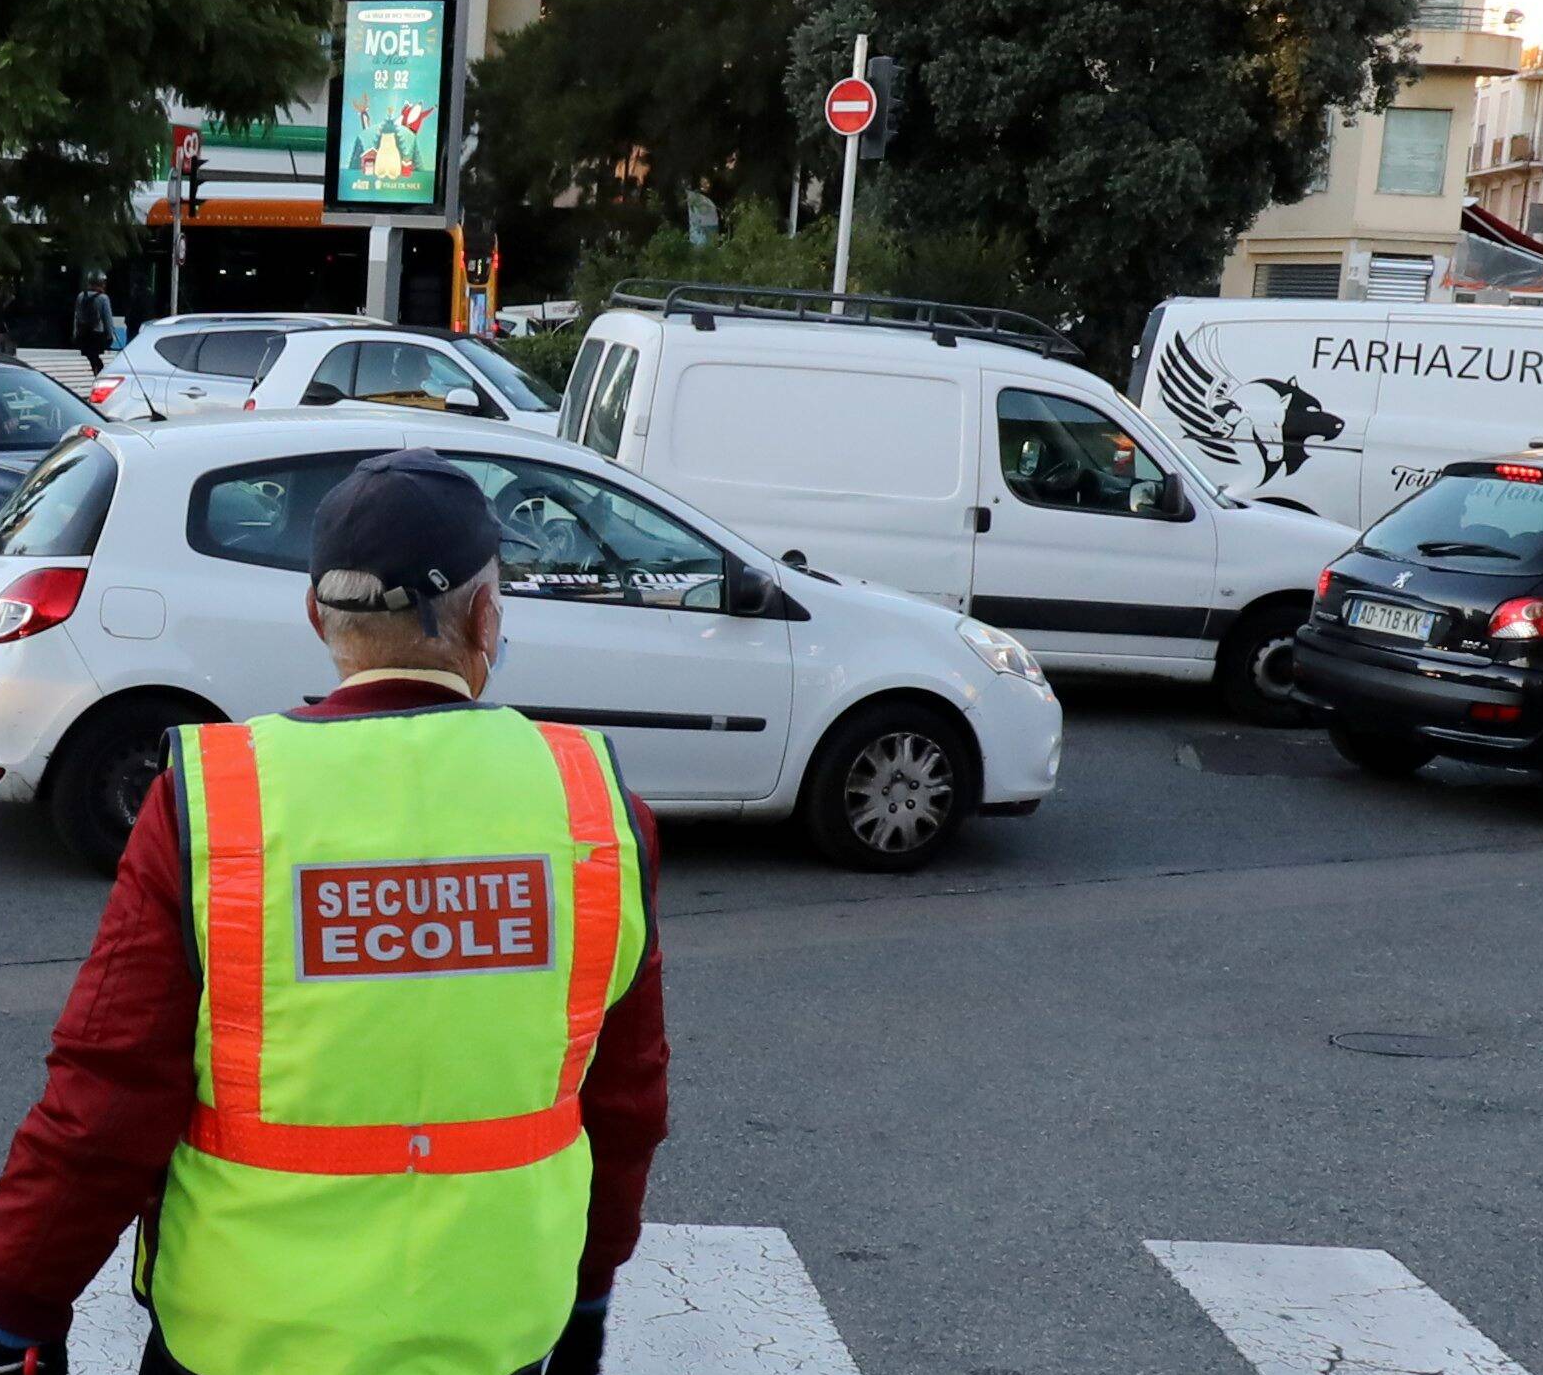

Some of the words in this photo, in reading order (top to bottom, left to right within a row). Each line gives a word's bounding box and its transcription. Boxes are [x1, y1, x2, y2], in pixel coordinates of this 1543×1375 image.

[364, 24, 425, 57] NOËL
[374, 69, 389, 82] 03
[394, 69, 410, 82] 02
[1312, 336, 1543, 384] FARHAZUR
[317, 872, 533, 919] SECURITE
[321, 917, 534, 964] ECOLE
